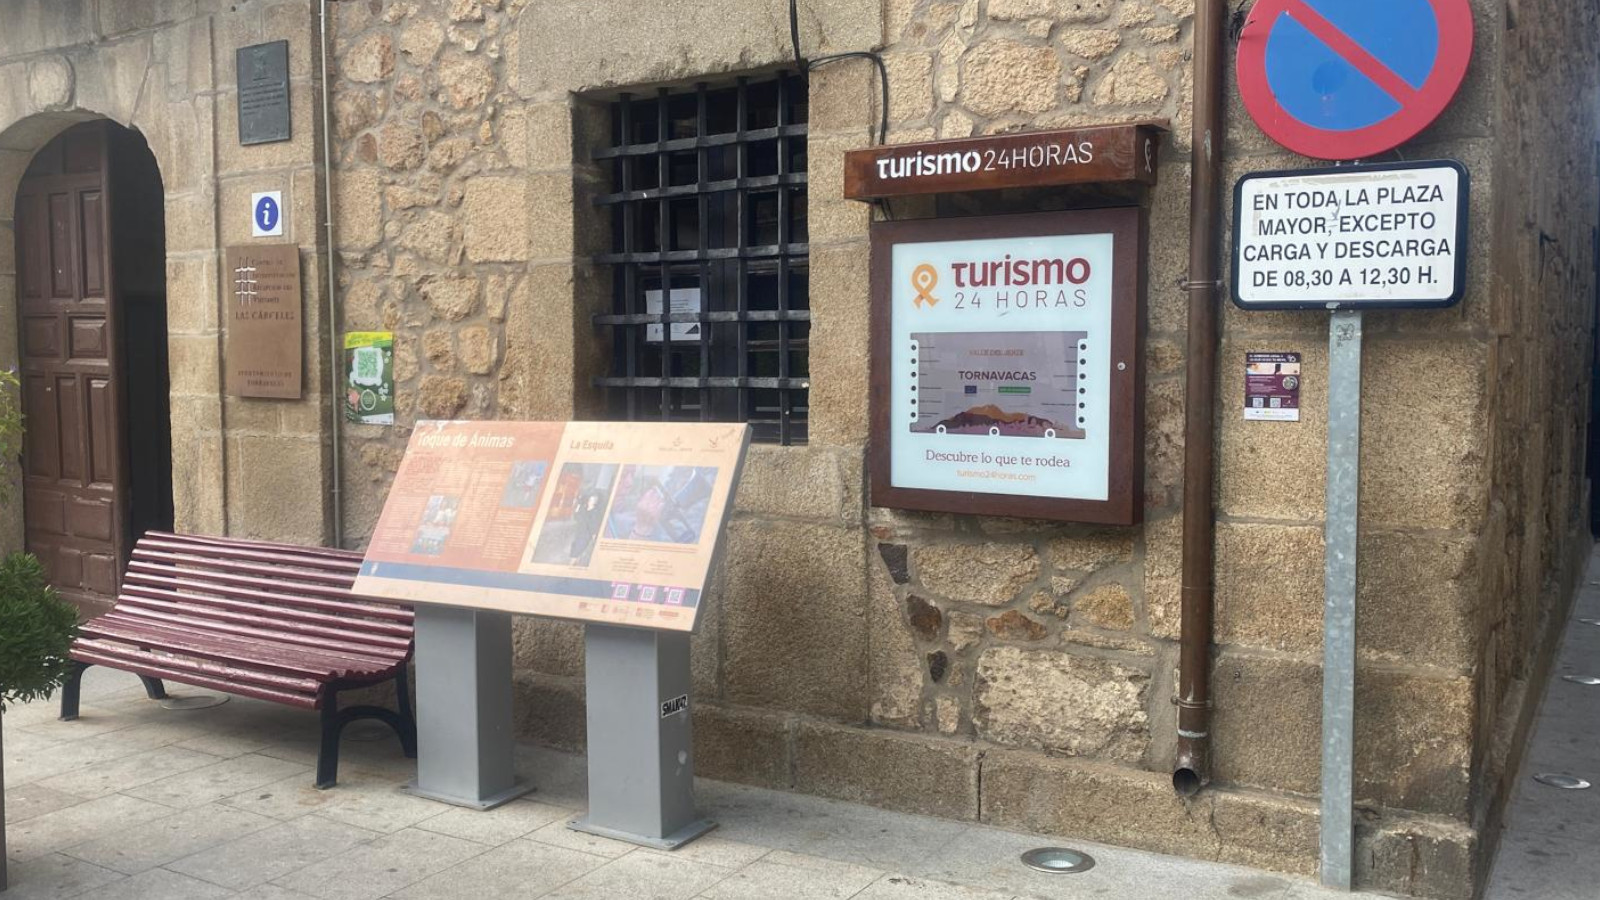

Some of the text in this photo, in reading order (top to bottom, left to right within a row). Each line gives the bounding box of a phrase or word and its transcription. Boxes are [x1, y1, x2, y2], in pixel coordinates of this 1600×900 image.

[877, 142, 1093, 179] turismo 24HORAS
[1253, 184, 1444, 211] EN TODA LA PLAZA
[1258, 211, 1436, 237] MAYOR, EXCEPTO
[1243, 238, 1451, 262] CARGA Y DESCARGA
[952, 255, 1090, 289] turismo
[1253, 265, 1438, 289] DE 08,30 A 12,30 H.
[954, 289, 1088, 309] 24 HORAS
[958, 370, 1037, 381] TORNAVACAS
[417, 430, 516, 448] Toque de Ánimas
[570, 439, 615, 451] La Esquila
[926, 450, 1071, 468] Descubre lo que te rodea
